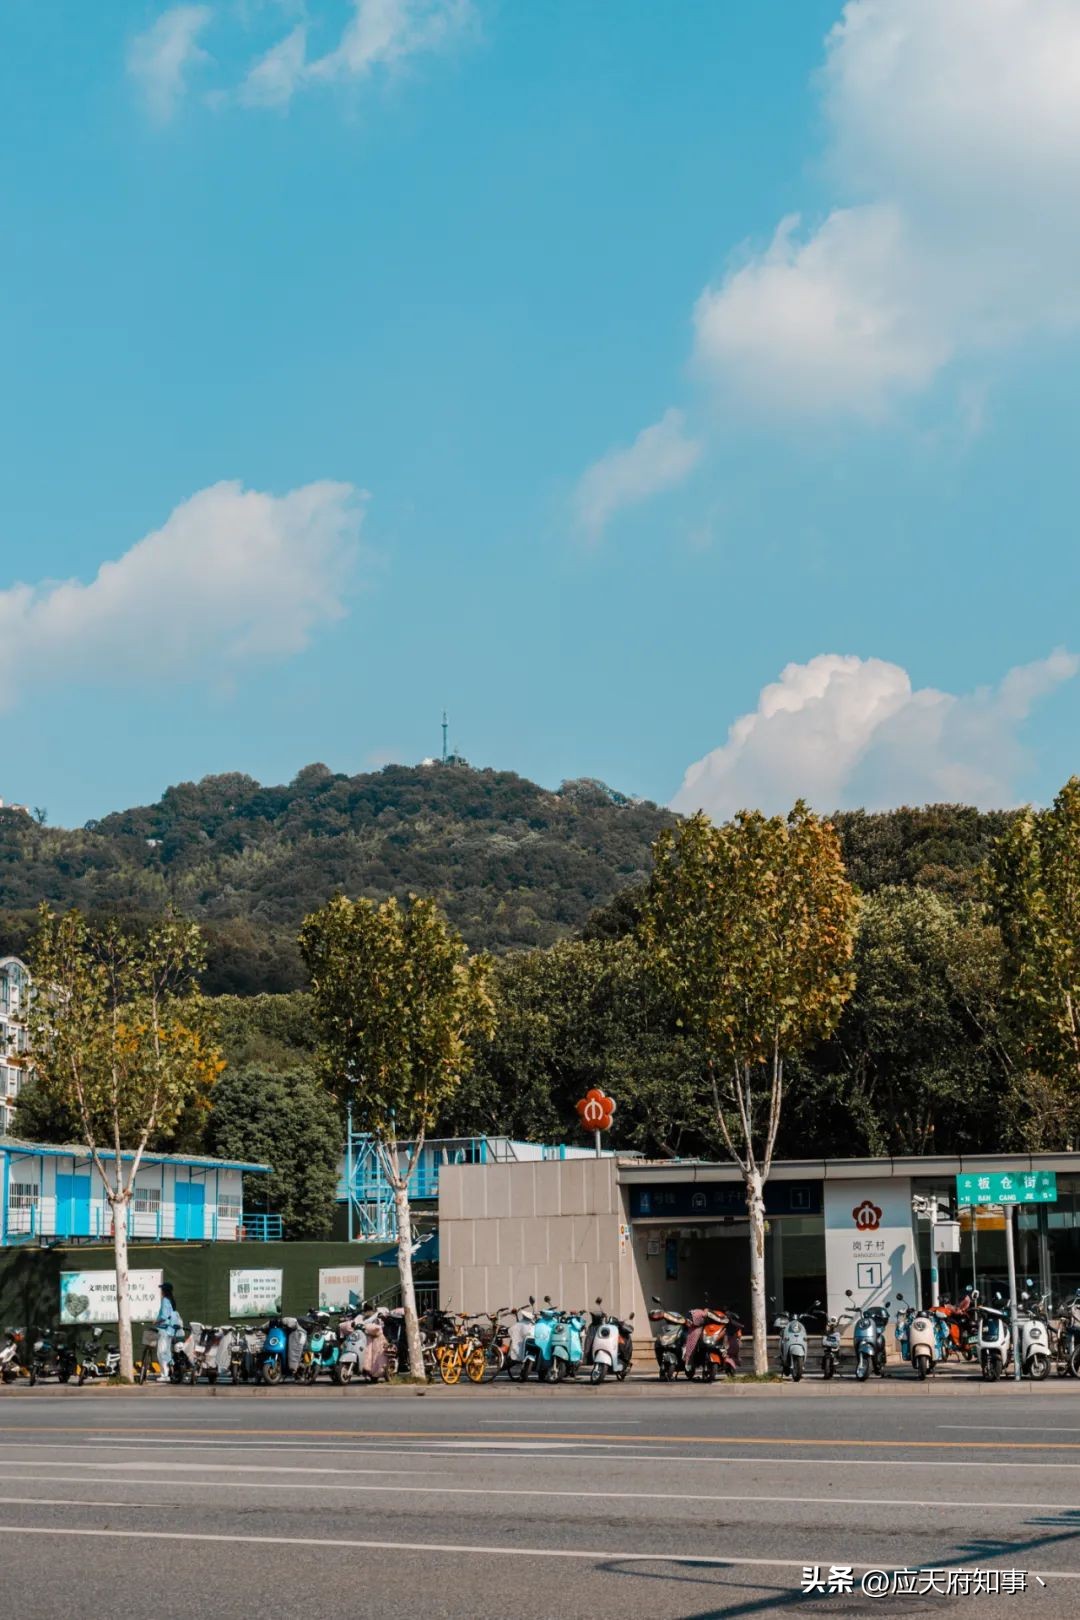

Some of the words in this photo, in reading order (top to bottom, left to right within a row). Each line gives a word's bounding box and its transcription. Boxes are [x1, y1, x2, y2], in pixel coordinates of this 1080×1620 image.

[978, 1176, 1037, 1190] 板仓街
[978, 1194, 991, 1202] BAN
[852, 1240, 886, 1251] 岗子村
[866, 1267, 874, 1284] 1
